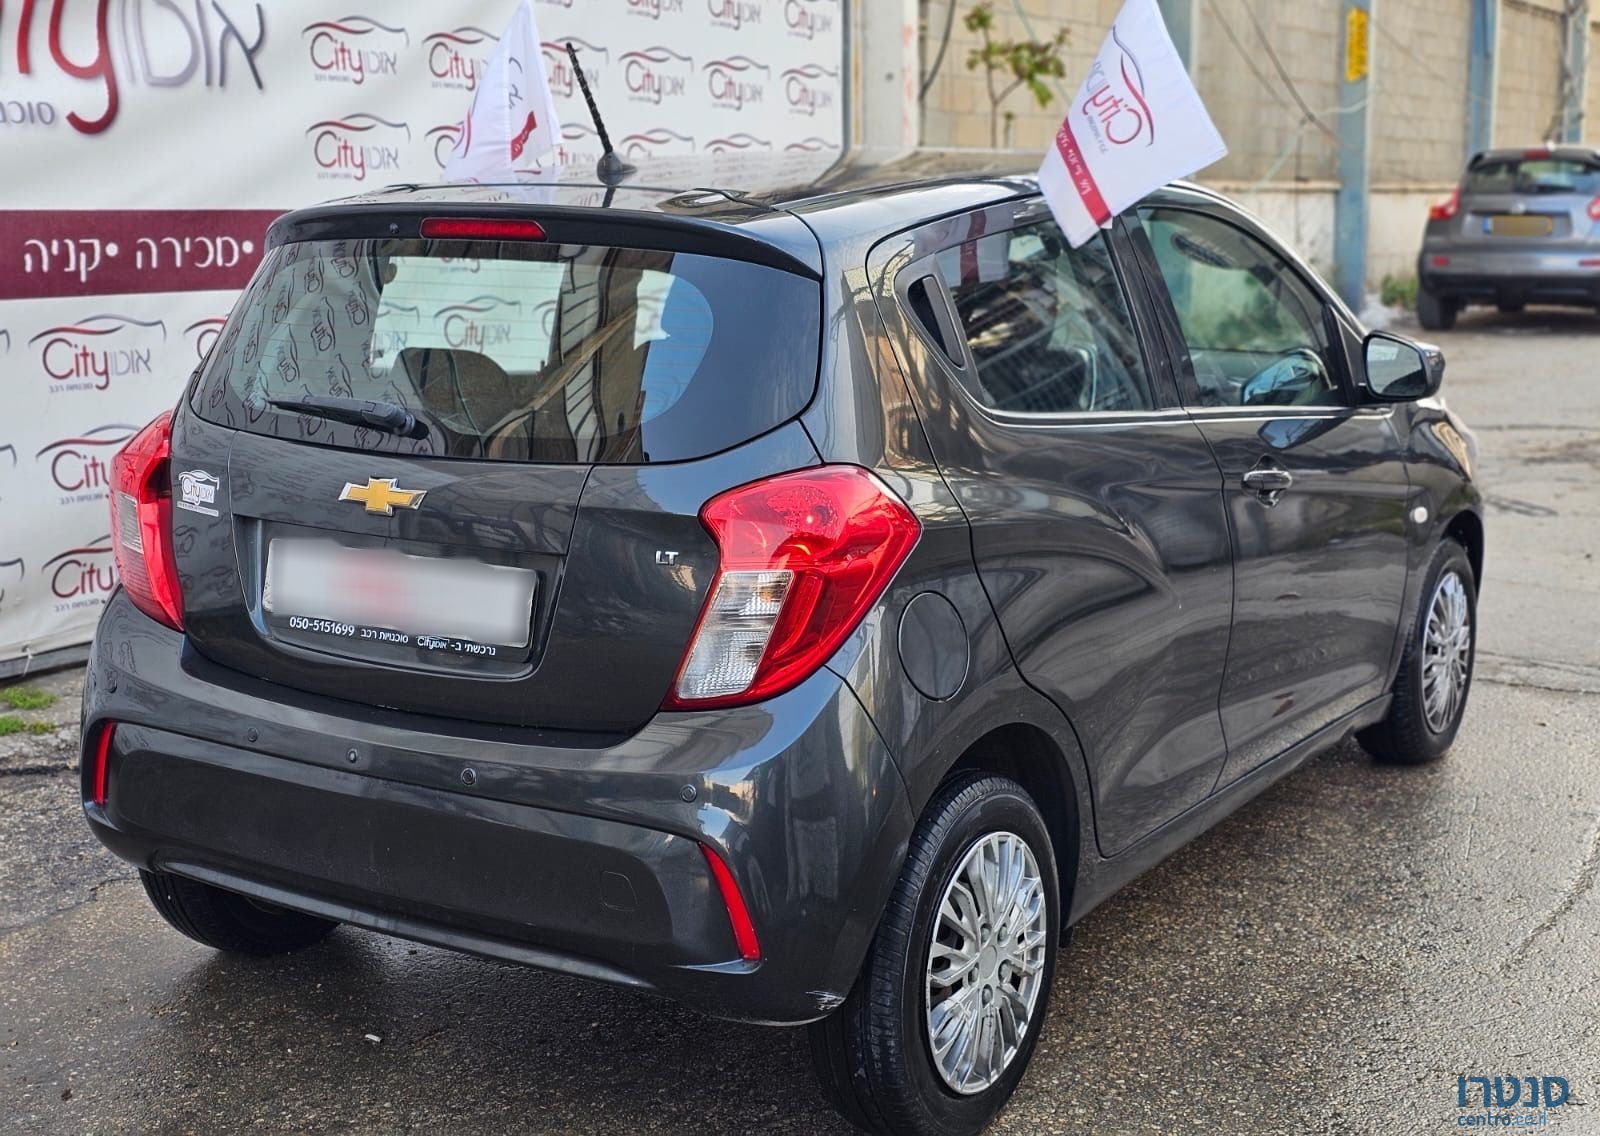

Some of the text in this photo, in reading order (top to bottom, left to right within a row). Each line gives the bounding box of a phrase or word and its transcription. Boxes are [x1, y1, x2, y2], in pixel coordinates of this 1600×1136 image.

[310, 31, 365, 85] City
[429, 41, 476, 91] City
[625, 59, 662, 105] City
[708, 68, 742, 111] City
[785, 76, 815, 117] City
[314, 130, 366, 181] City
[24, 236, 240, 283] מכירה קניה
[444, 314, 486, 353] City
[42, 337, 110, 391] City
[655, 550, 679, 565] LT
[289, 616, 355, 636] 050-5151699
[360, 628, 377, 639] רכב
